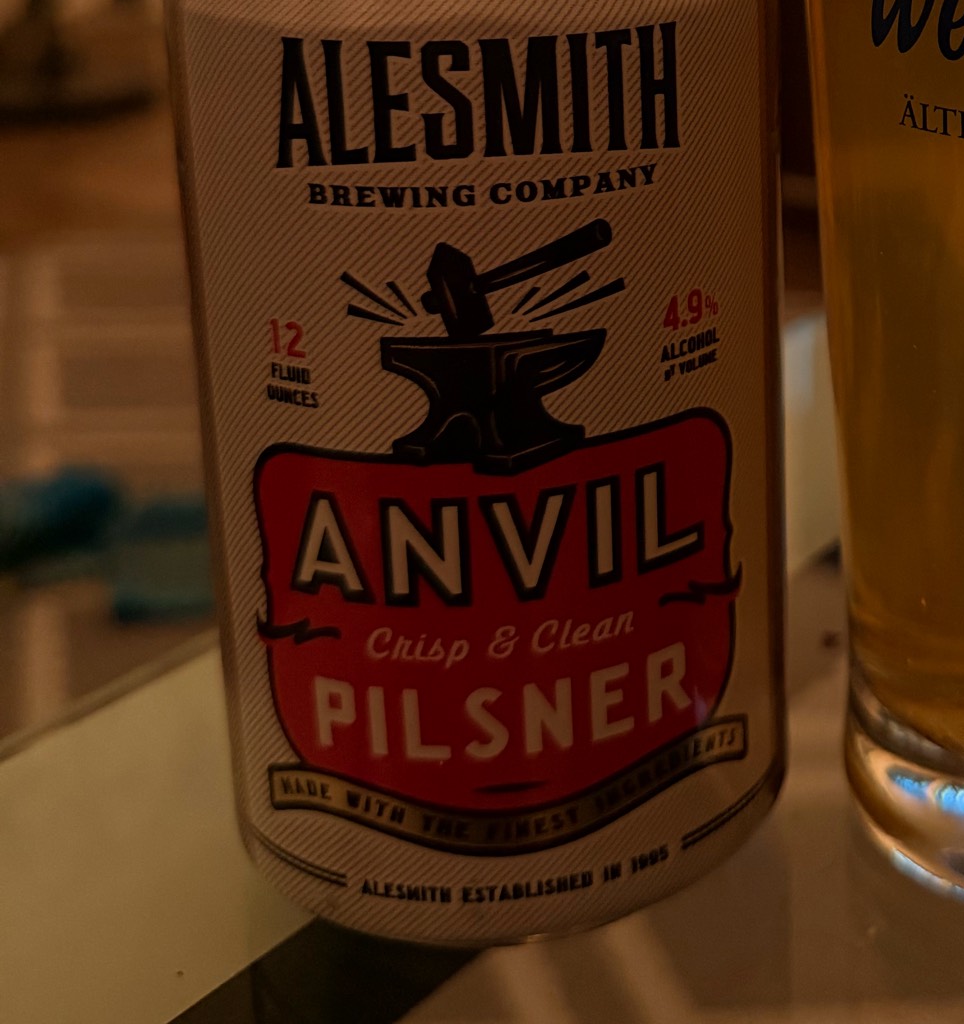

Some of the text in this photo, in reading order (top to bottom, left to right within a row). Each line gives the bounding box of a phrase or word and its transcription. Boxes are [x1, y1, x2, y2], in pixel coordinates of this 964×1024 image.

[276, 21, 681, 168] ALESMITH
[308, 163, 658, 208] BREWING COMPANY
[662, 287, 719, 331] 4.9%
[269, 318, 307, 359] 12
[660, 326, 720, 363] ALCOHOL
[270, 361, 312, 385] FLUID
[679, 348, 718, 375] VOLUME
[266, 383, 320, 409] OUNCES
[290, 462, 706, 608] ANVIL
[366, 609, 635, 670] Crisp & Clean
[312, 640, 694, 764] PILSNER
[280, 776, 332, 802] MADE
[346, 789, 408, 825] WITH
[422, 813, 471, 841] THE
[360, 879, 453, 905] ALESMITH
[460, 869, 593, 905] ESTABLISHED
[603, 860, 622, 883] IN
